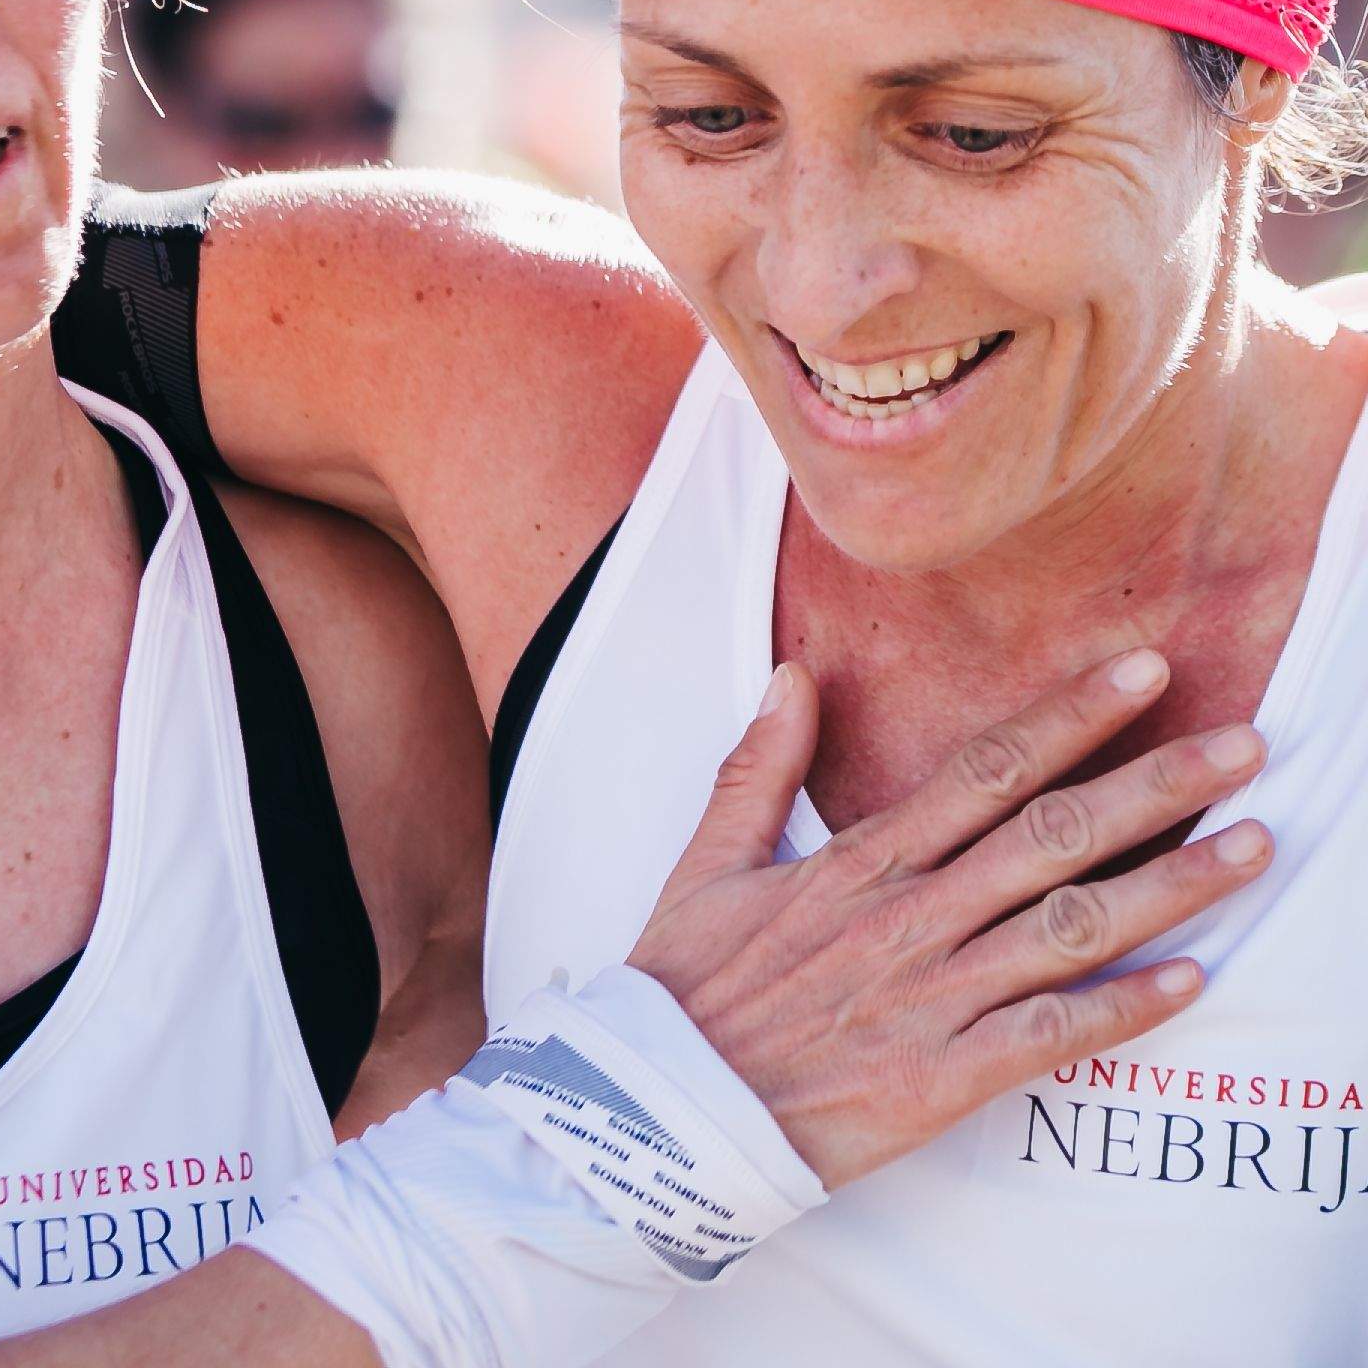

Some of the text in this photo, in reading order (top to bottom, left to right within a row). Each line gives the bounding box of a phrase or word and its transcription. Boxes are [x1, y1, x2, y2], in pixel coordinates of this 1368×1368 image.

[118, 290, 160, 395] ROCKBROS
[543, 1112, 631, 1162] ROCKBROS
[588, 1161, 675, 1218] ROCKBROS
[654, 1169, 735, 1221] ROCKBROS
